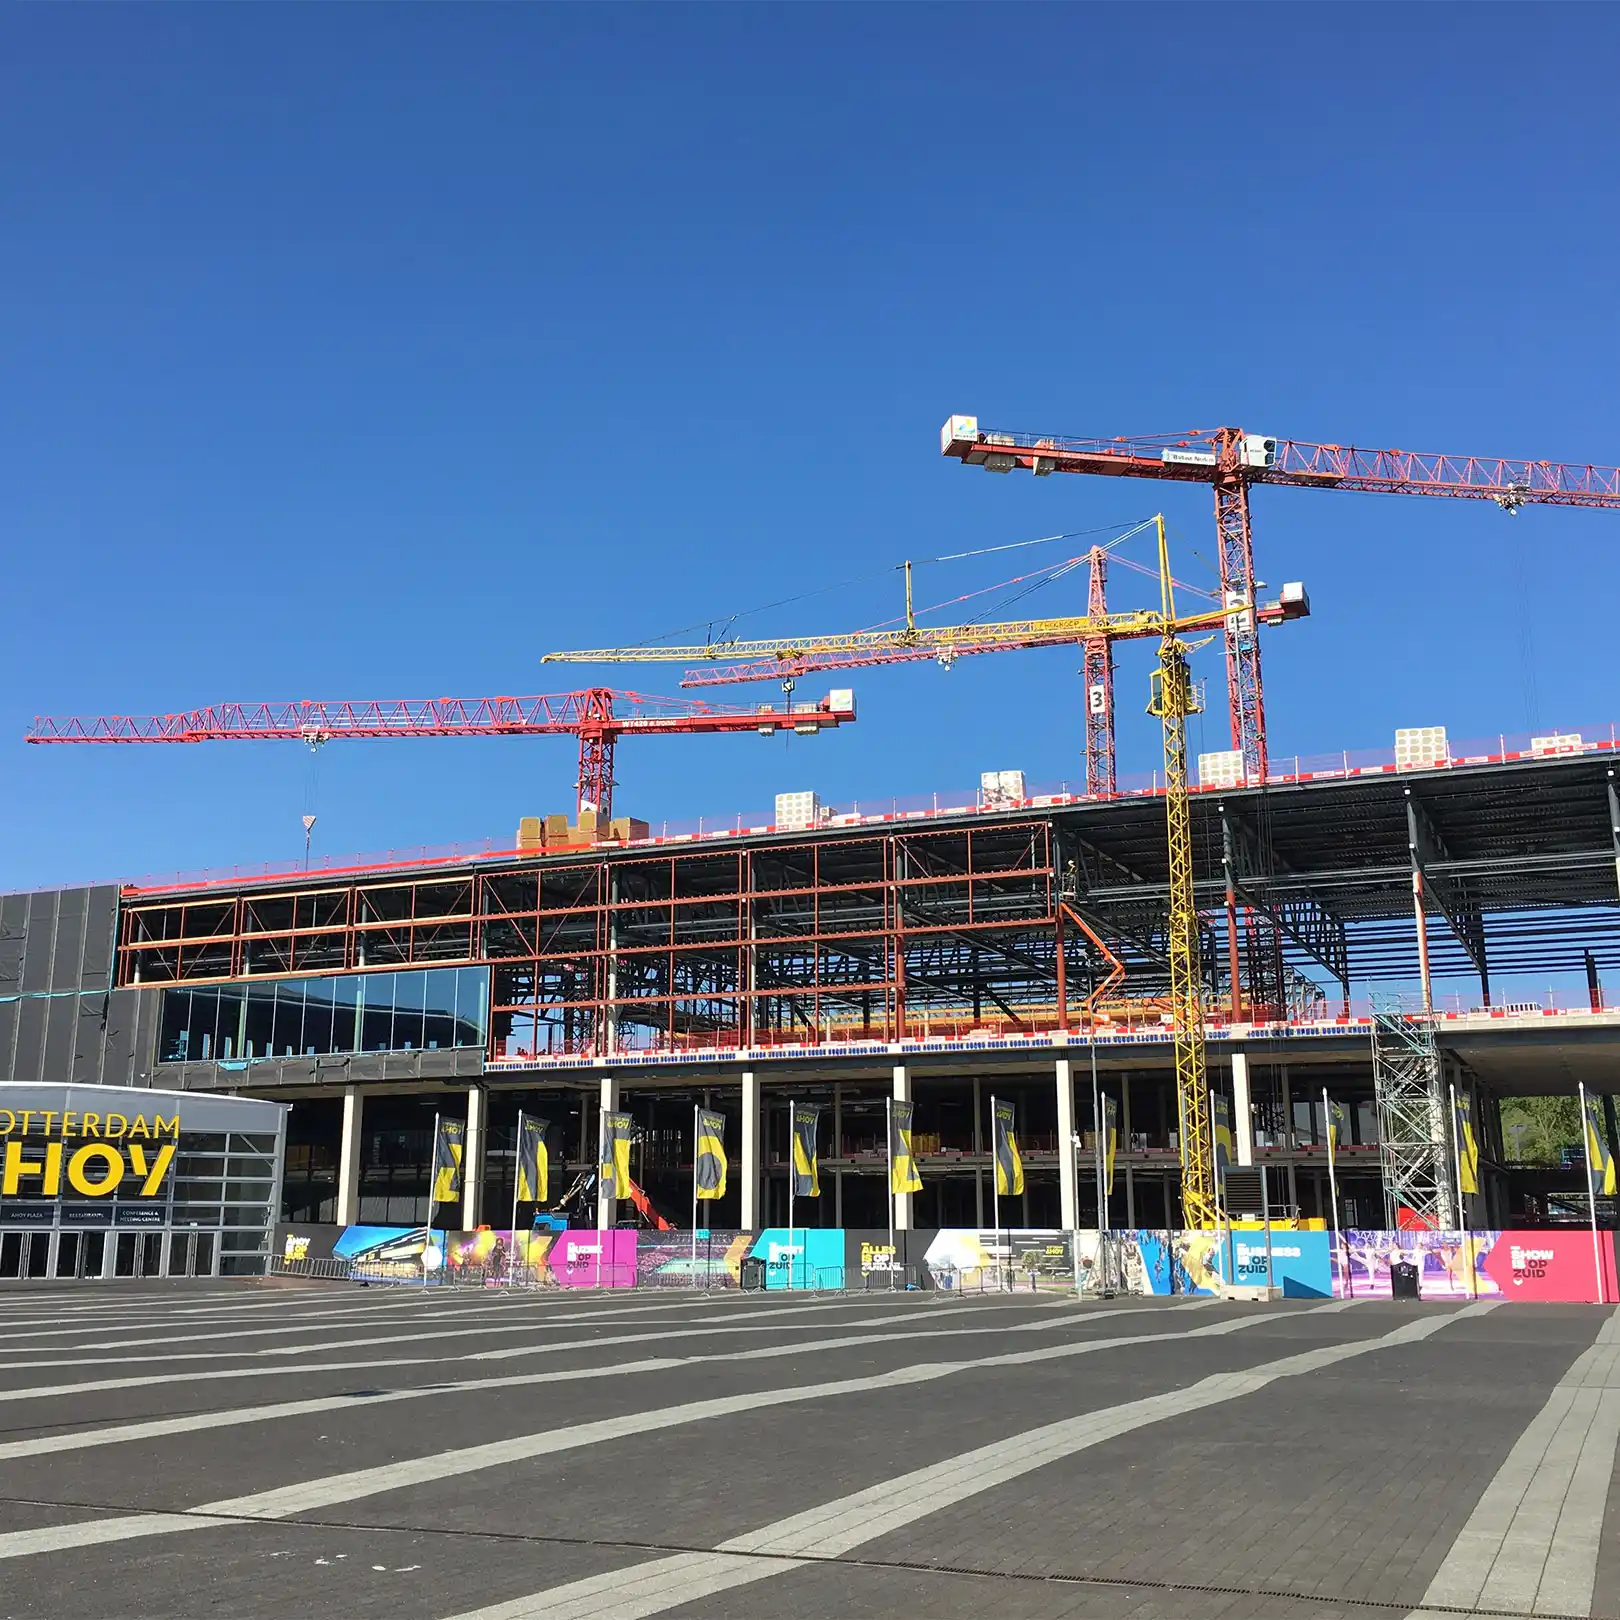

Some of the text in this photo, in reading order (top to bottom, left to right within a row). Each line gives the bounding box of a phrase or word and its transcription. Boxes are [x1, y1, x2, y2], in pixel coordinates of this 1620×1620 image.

[1093, 691, 1103, 708] 3
[861, 1245, 896, 1254] ALLES
[578, 1253, 591, 1261] OP
[781, 1253, 796, 1262] OP
[873, 1254, 889, 1263] OP
[1511, 1249, 1554, 1260] SHOW
[566, 1261, 589, 1269] ZUID
[861, 1262, 904, 1271] ZUID.NL
[1528, 1259, 1548, 1269] OP
[1238, 1264, 1268, 1274] ZUID
[1513, 1268, 1546, 1278] ZUID
